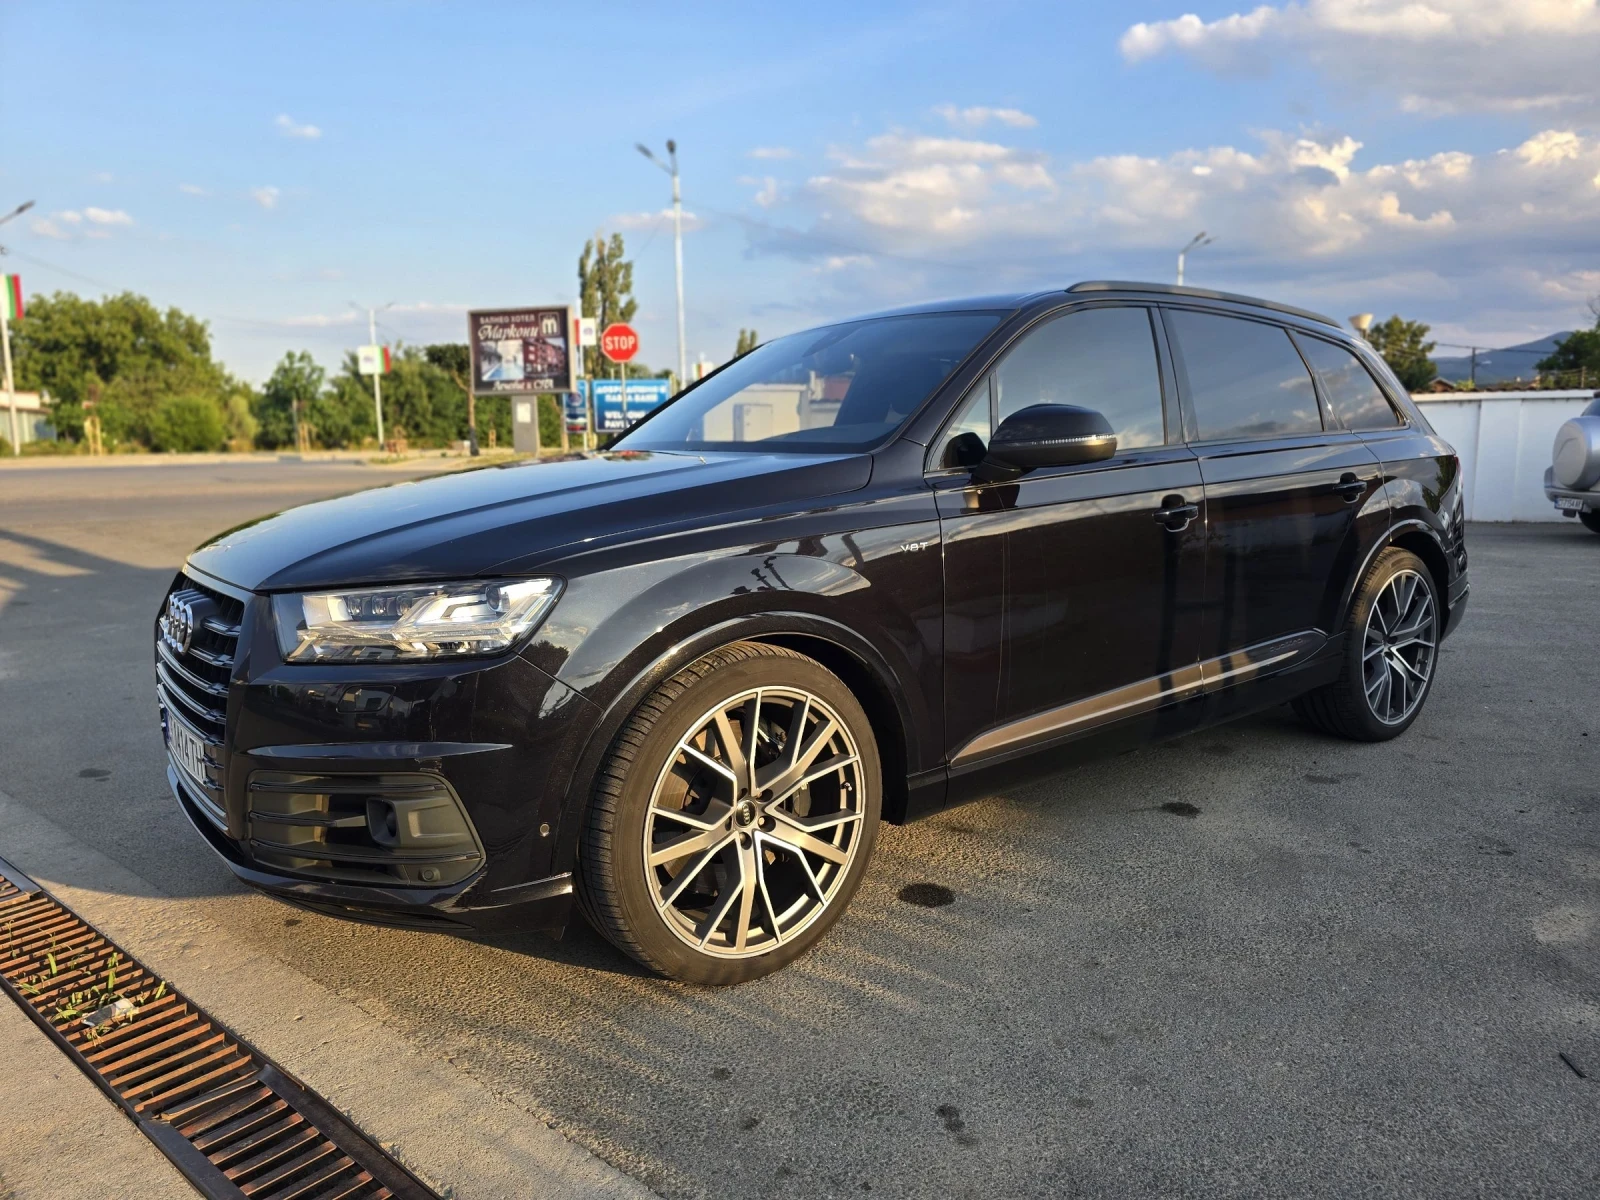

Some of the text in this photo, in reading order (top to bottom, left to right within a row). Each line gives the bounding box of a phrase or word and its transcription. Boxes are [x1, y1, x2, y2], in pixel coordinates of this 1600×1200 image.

[478, 323, 539, 341] Маркони
[605, 335, 635, 351] STOP
[605, 411, 646, 419] WELOM
